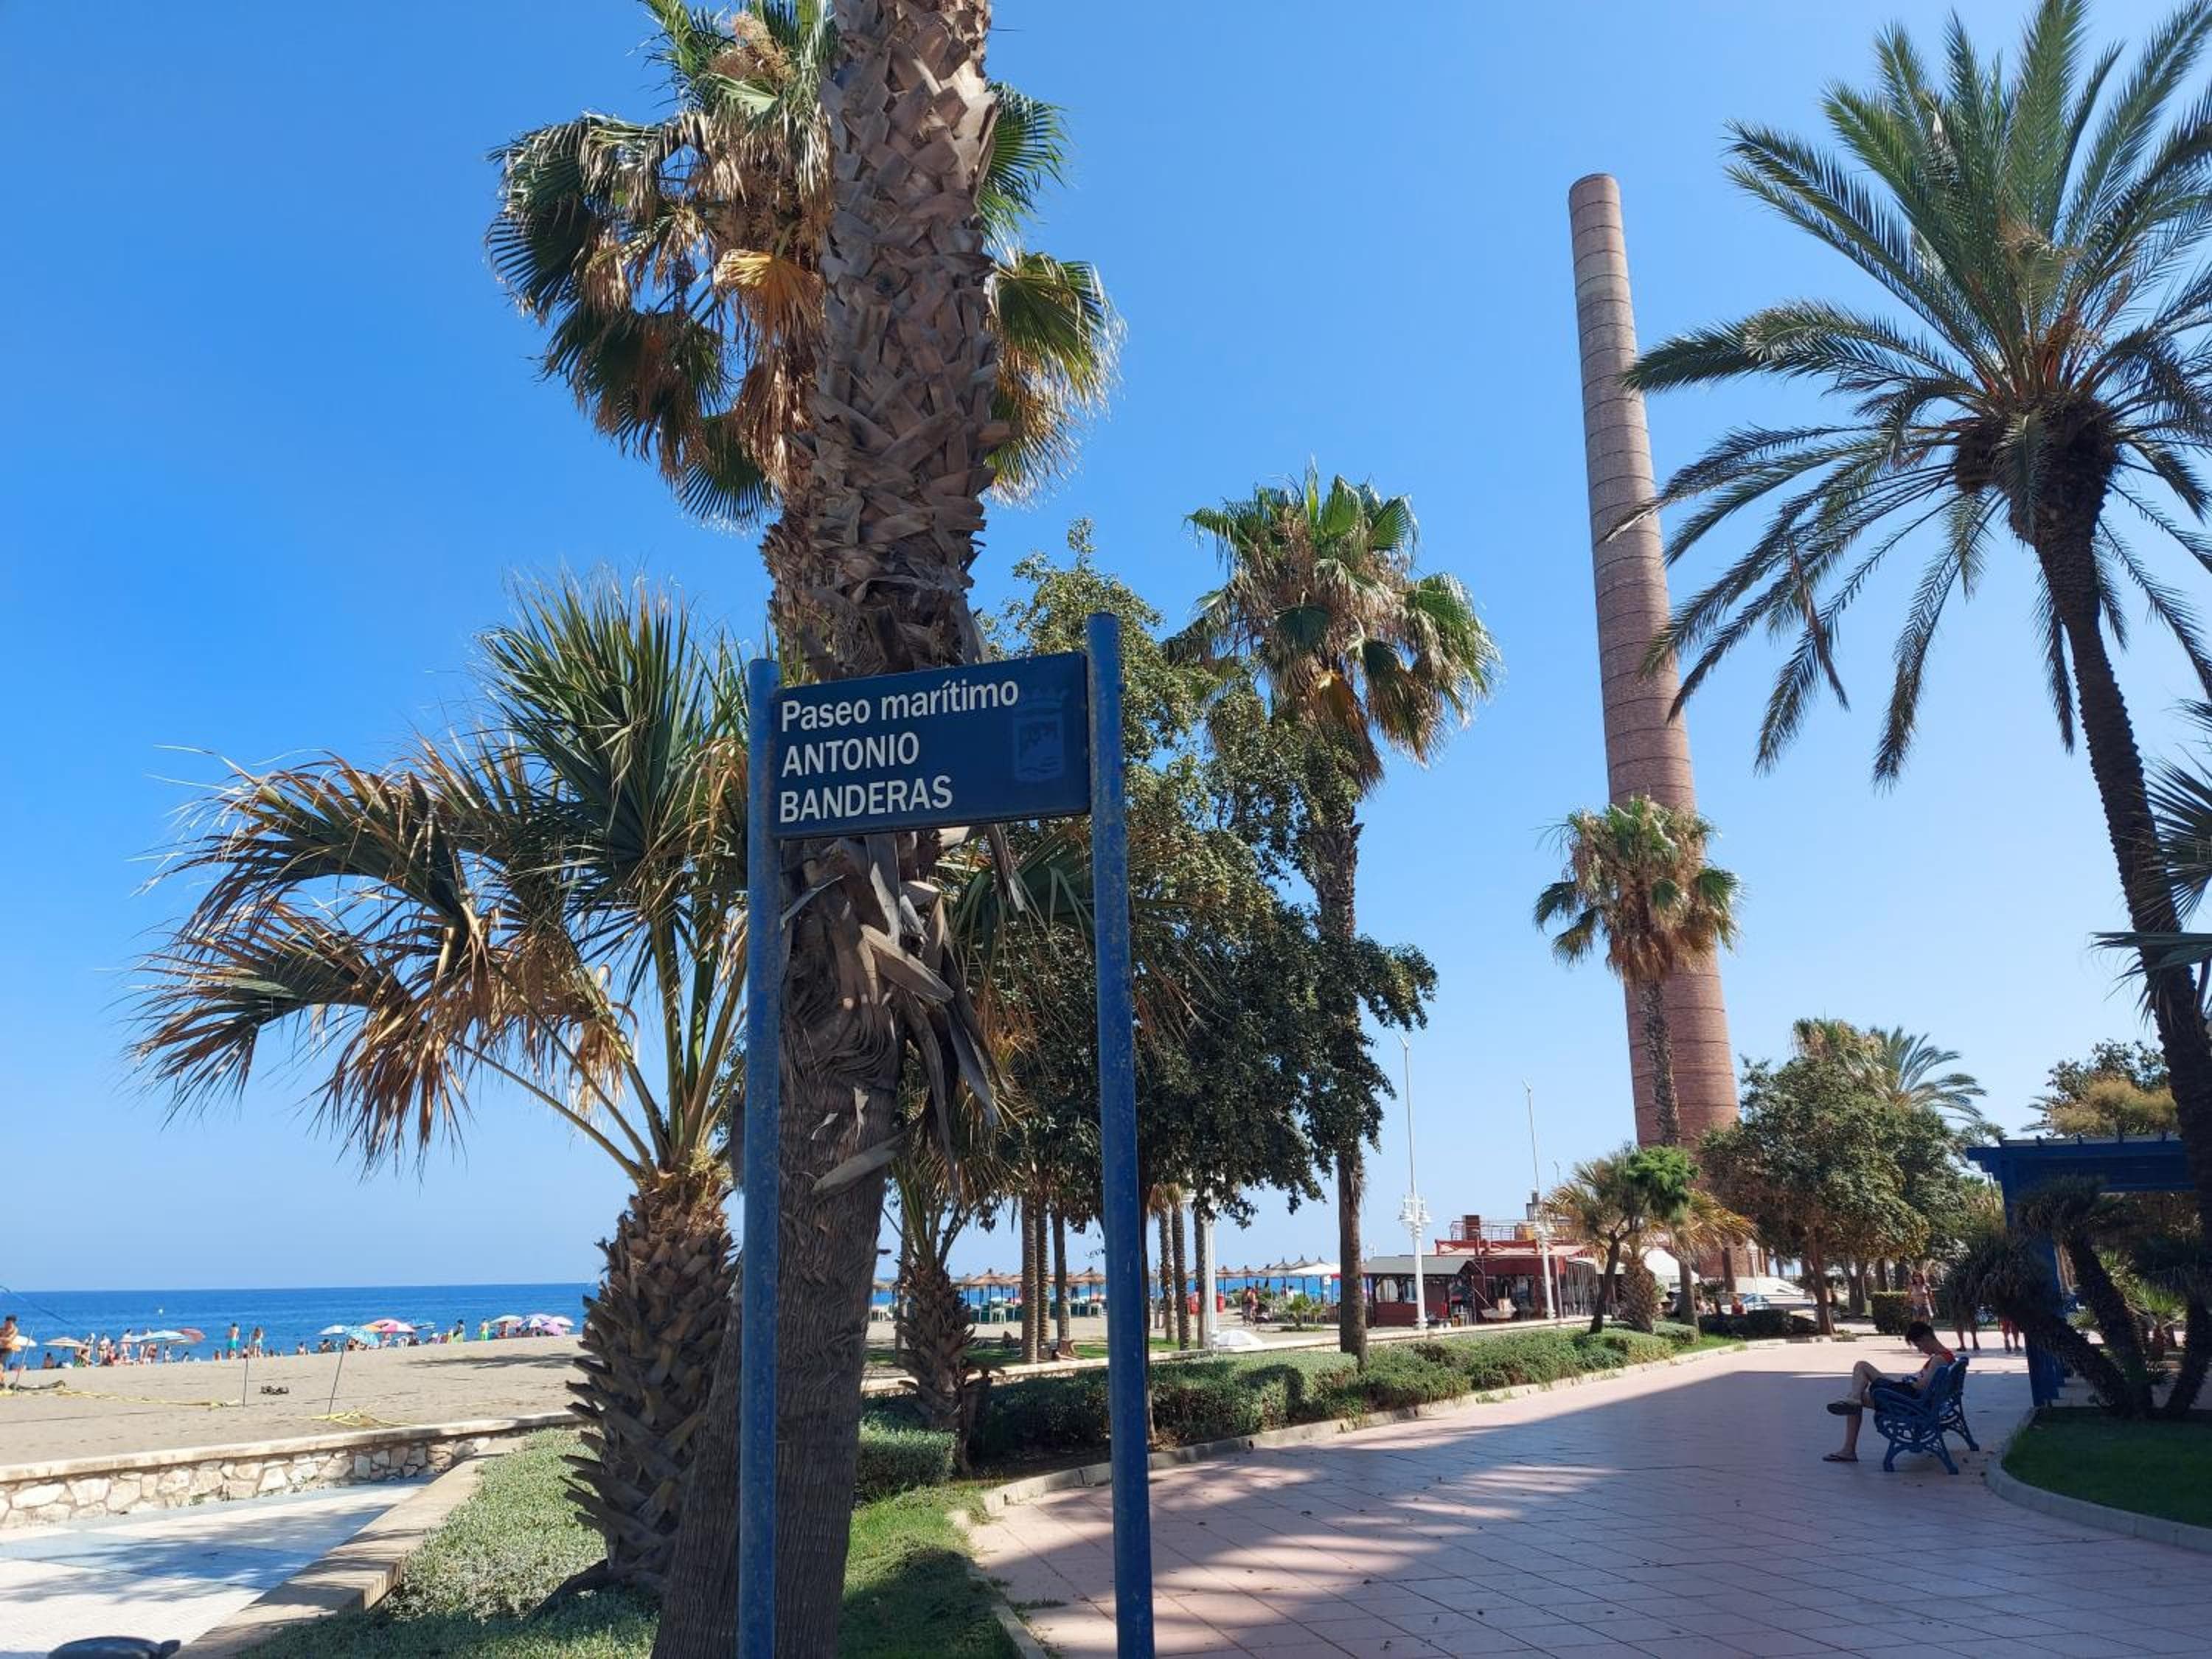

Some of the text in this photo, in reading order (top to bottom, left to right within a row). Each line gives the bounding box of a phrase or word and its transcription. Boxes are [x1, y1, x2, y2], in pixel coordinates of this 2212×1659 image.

[782, 680, 1019, 732] Paseo marítimo
[782, 731, 919, 778] ANTONIO
[779, 774, 953, 824] BANDERAS
